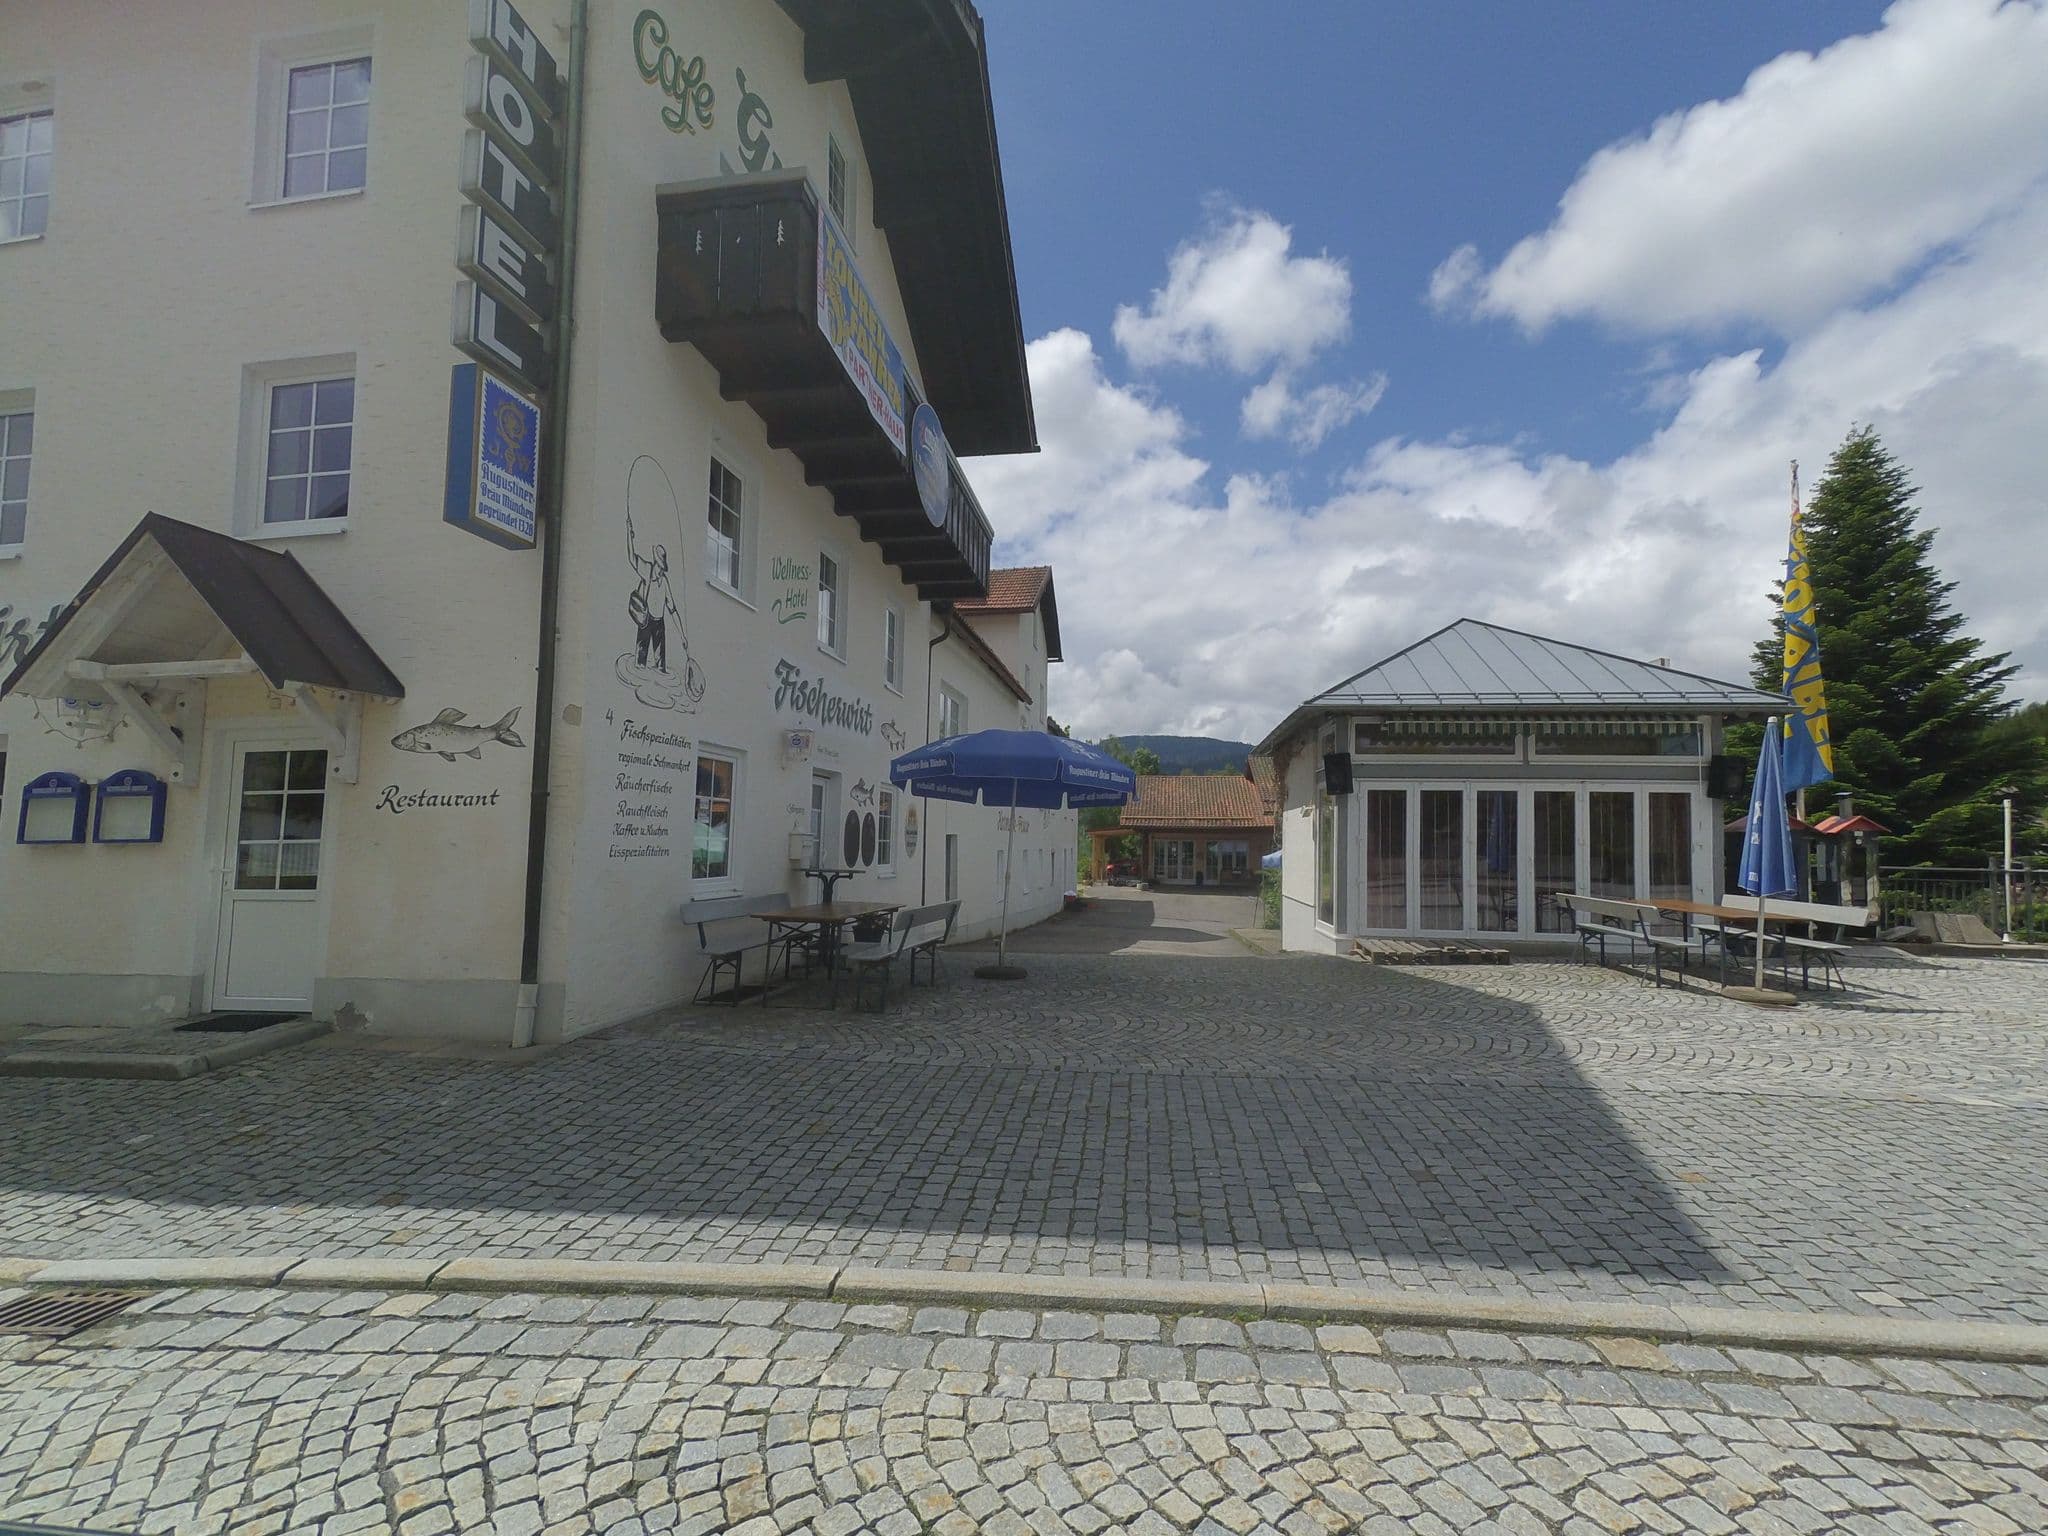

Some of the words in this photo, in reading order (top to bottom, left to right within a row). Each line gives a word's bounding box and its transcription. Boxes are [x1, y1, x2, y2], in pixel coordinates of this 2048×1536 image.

[478, 0, 537, 371] HOTEL
[785, 588, 808, 608] Hotel
[774, 658, 873, 736] Fischerwirt
[605, 708, 614, 726] 4
[620, 719, 692, 749] Fischspezialitäten
[617, 752, 653, 768] regionale
[615, 772, 673, 795] Räucherfische
[375, 785, 500, 814] Restaurant
[616, 799, 669, 819] Rauchfleisch
[612, 822, 640, 838] Kaffee
[609, 844, 670, 862] Eisspezialitäten
